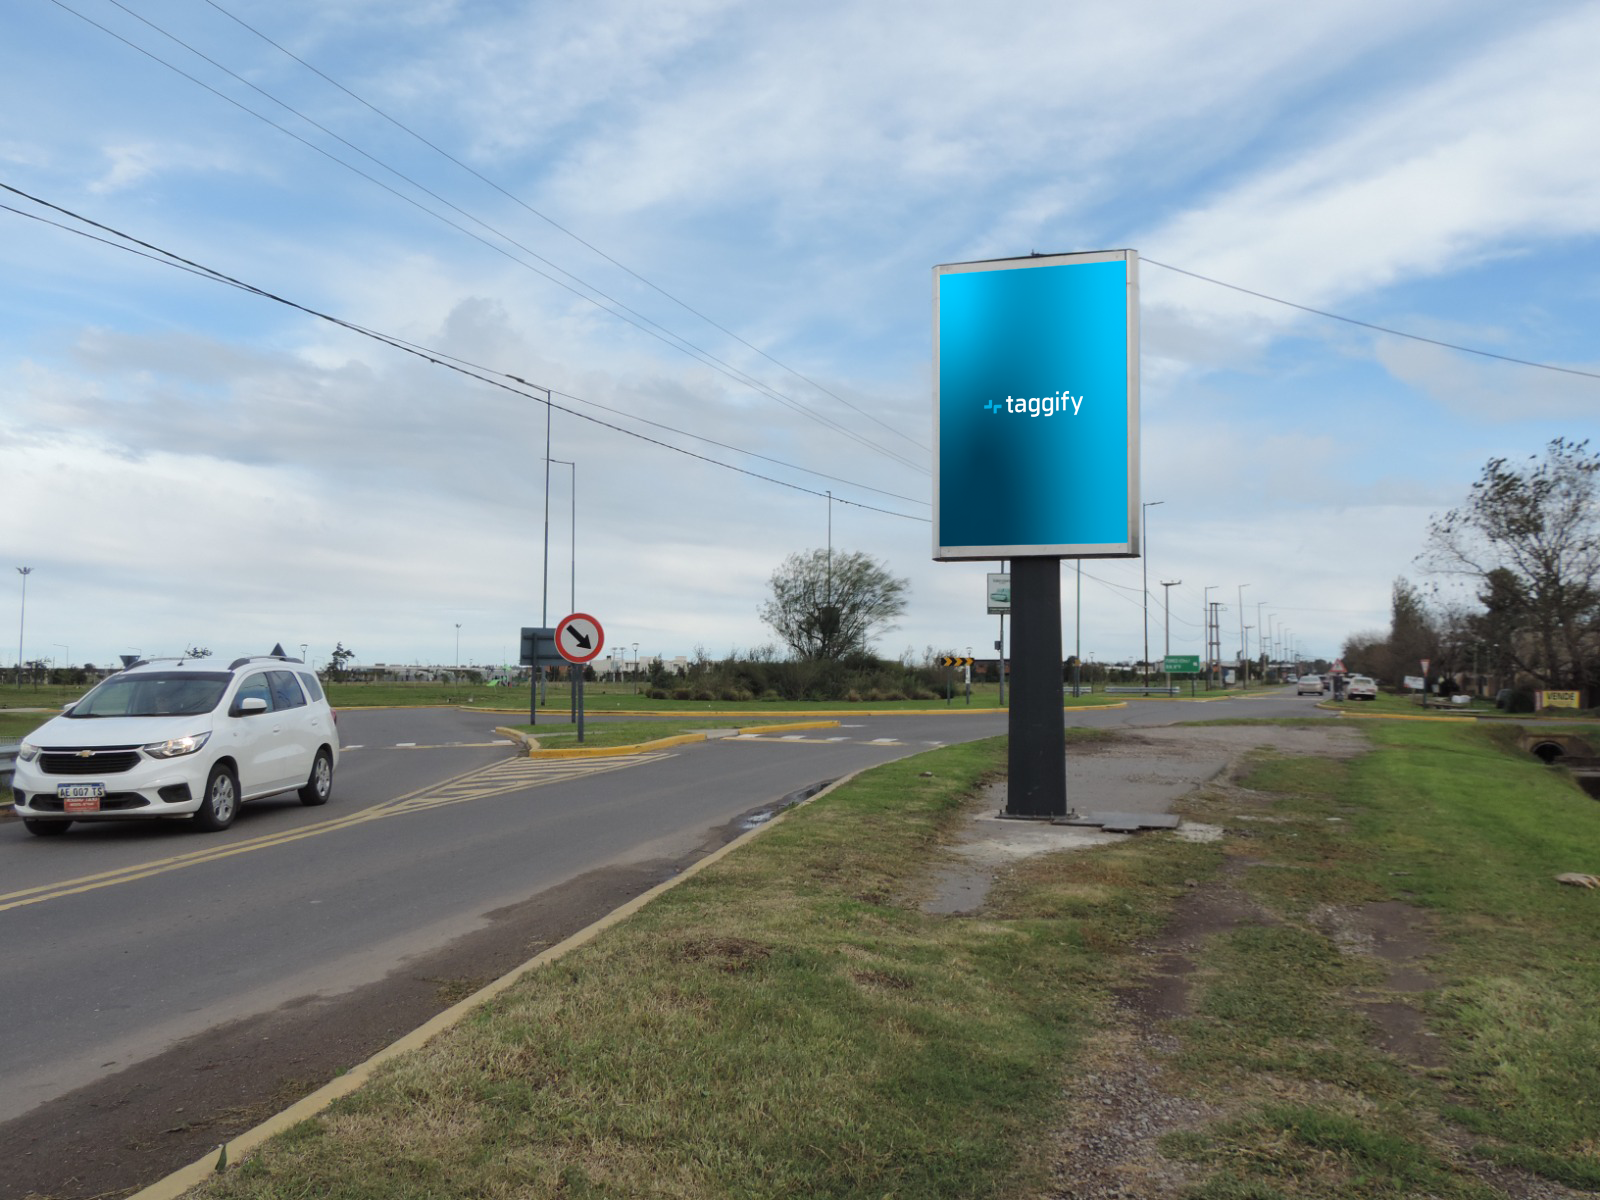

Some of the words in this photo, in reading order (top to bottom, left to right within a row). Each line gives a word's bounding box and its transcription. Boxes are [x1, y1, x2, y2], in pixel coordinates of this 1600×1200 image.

[1005, 390, 1084, 418] taggify
[1547, 692, 1575, 701] VENDE
[60, 787, 71, 797] AE
[73, 787, 89, 797] 007
[92, 787, 103, 796] TS
